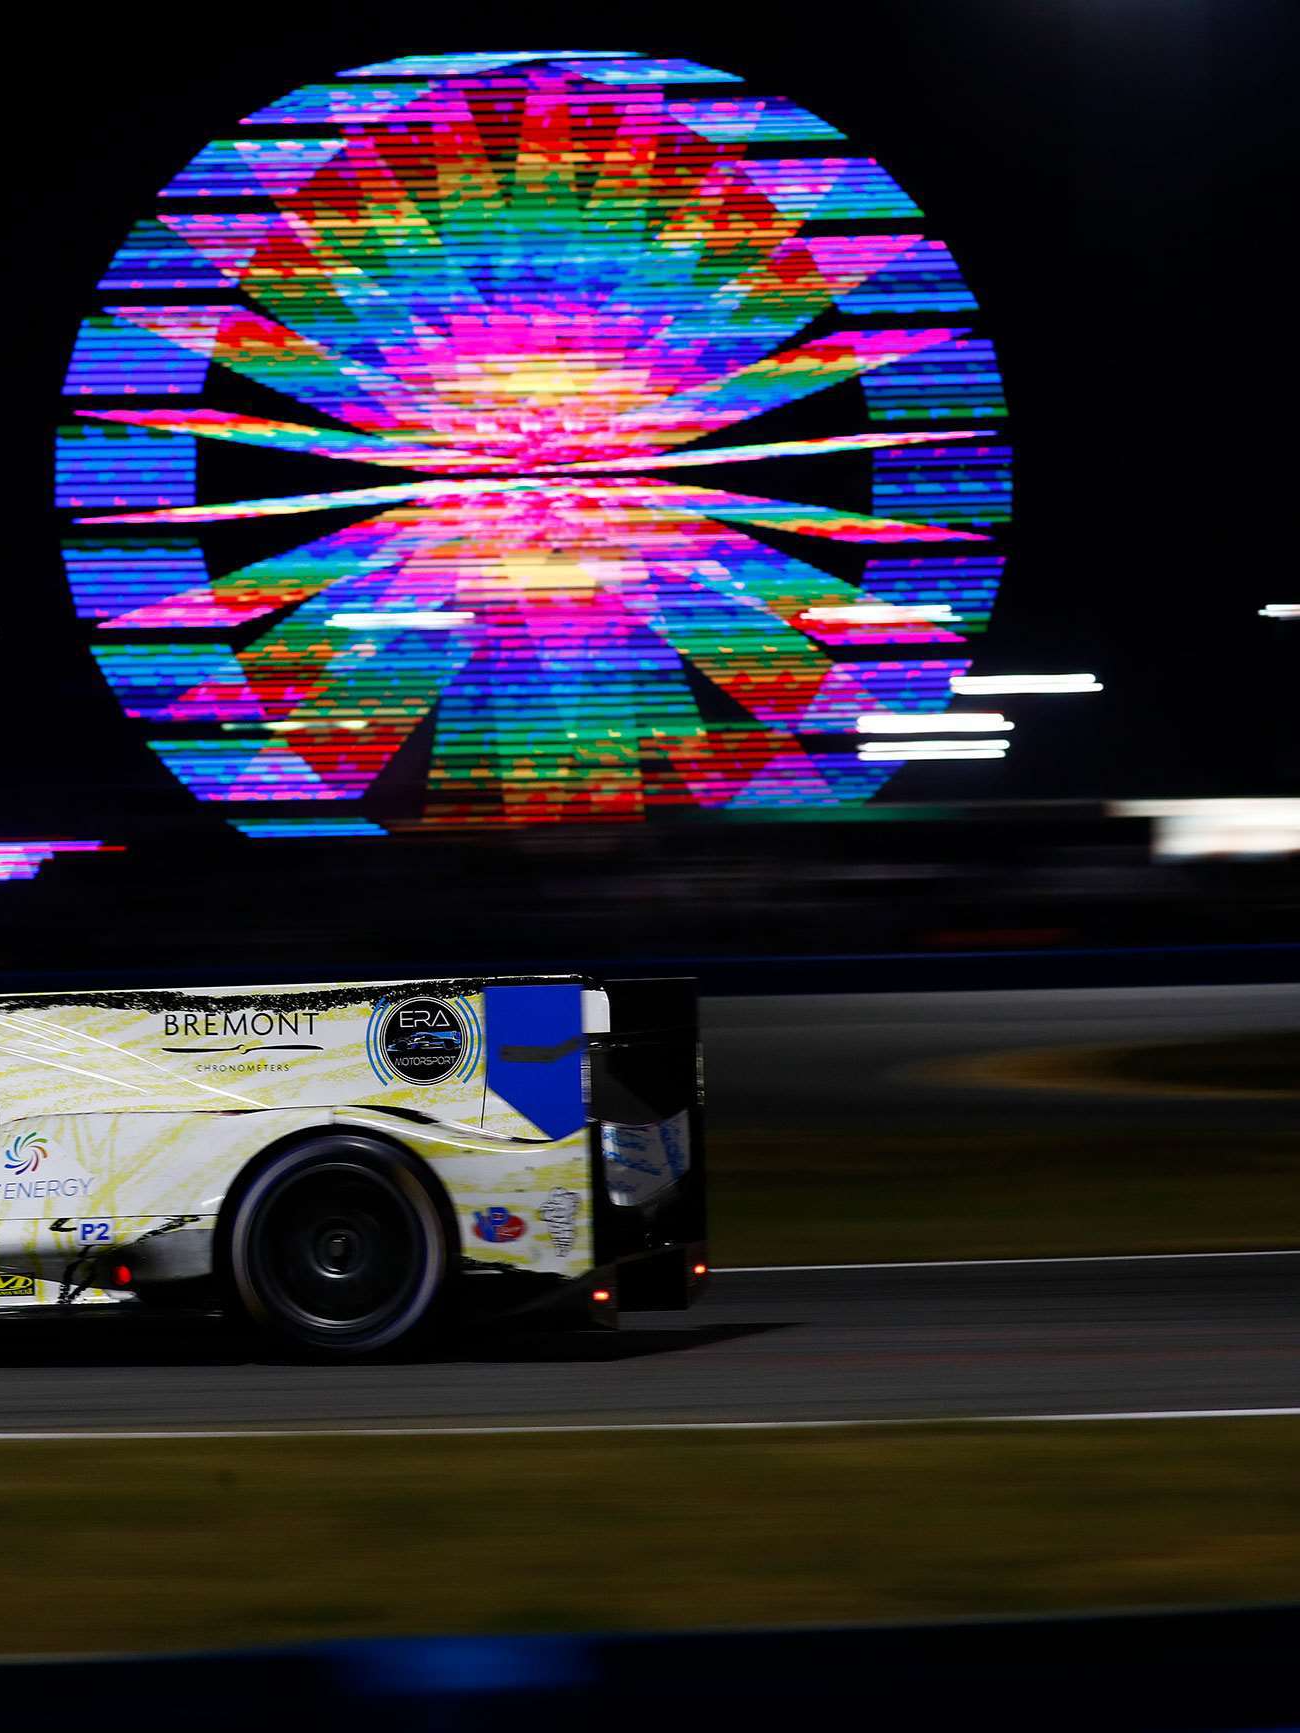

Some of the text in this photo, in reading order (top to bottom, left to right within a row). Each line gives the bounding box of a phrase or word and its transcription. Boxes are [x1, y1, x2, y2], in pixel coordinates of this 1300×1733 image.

[164, 1013, 320, 1036] BREMONT
[399, 1010, 451, 1028] ERA
[196, 1064, 291, 1073] CHRONOMETERS
[395, 1056, 457, 1067] MOTORSPORT
[4, 1177, 94, 1200] ENERGY
[81, 1222, 110, 1241] P2
